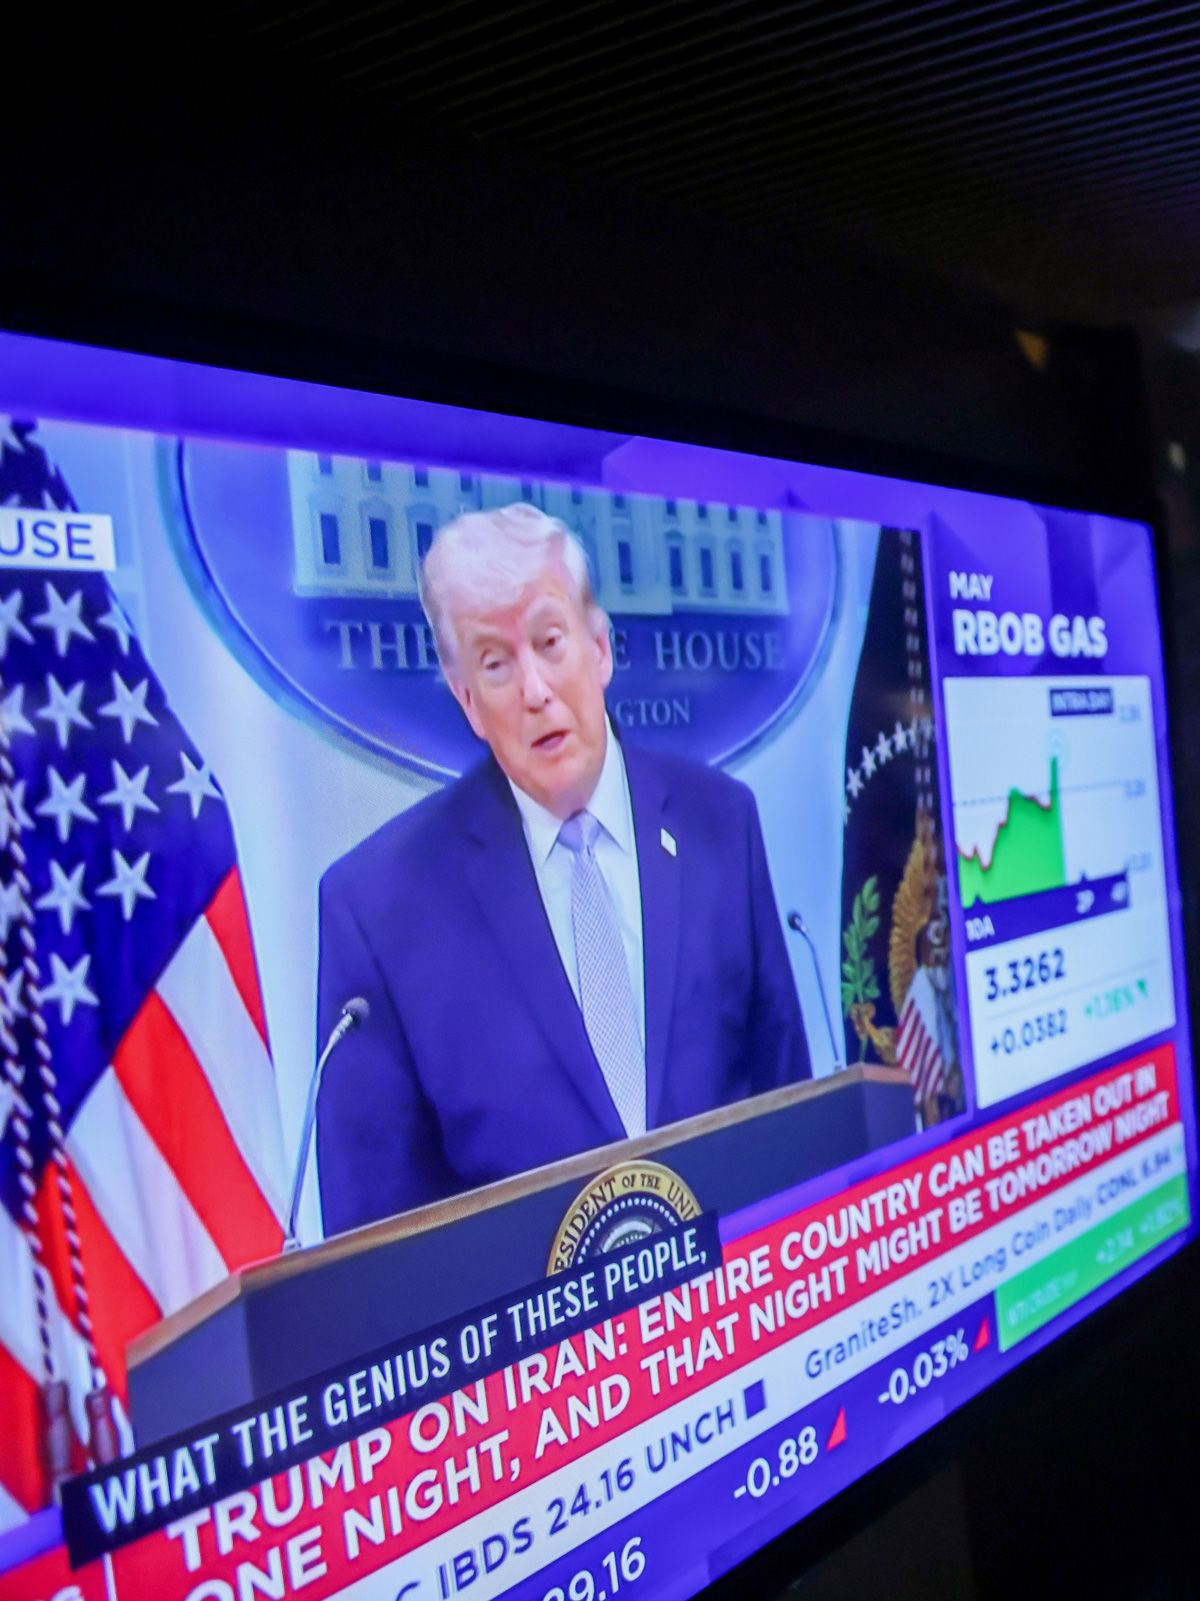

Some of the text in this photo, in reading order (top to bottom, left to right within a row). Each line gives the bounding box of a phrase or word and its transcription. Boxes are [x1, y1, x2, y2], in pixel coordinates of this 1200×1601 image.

[654, 630, 785, 671] HOUSE
[949, 570, 993, 600] MAY
[952, 608, 1109, 659] RBOB GAS
[985, 948, 1066, 1001] 3.3262
[622, 1173, 637, 1188] OF
[640, 1173, 660, 1190] THE
[164, 1063, 1156, 1572] TRUMP ON IRAN: ENTIRE COUNTRY CAN BE TAKEN OUT IN
[343, 1430, 520, 1560] NIGHT,
[534, 1374, 631, 1459] AND
[640, 1312, 740, 1396] THAT
[749, 1256, 849, 1341] NIGHT
[856, 1208, 943, 1284] MIGHT
[948, 1188, 984, 1234] BE
[984, 1118, 1114, 1212] TOMORROW
[1113, 1091, 1170, 1144] NIGHT
[804, 1297, 922, 1380] GraniteSh.
[927, 1273, 956, 1308] 2X
[960, 1247, 1008, 1289] Long
[1011, 1220, 1050, 1256] Coin
[1054, 1195, 1092, 1234] Daily
[89, 1228, 707, 1534] WHAT THE GENIUS OF THESE PEOPLE,
[543, 1328, 969, 1601] 9.16 -0.88 -0.03%
[435, 1399, 737, 1600] IBDS 24.16 UNCH
